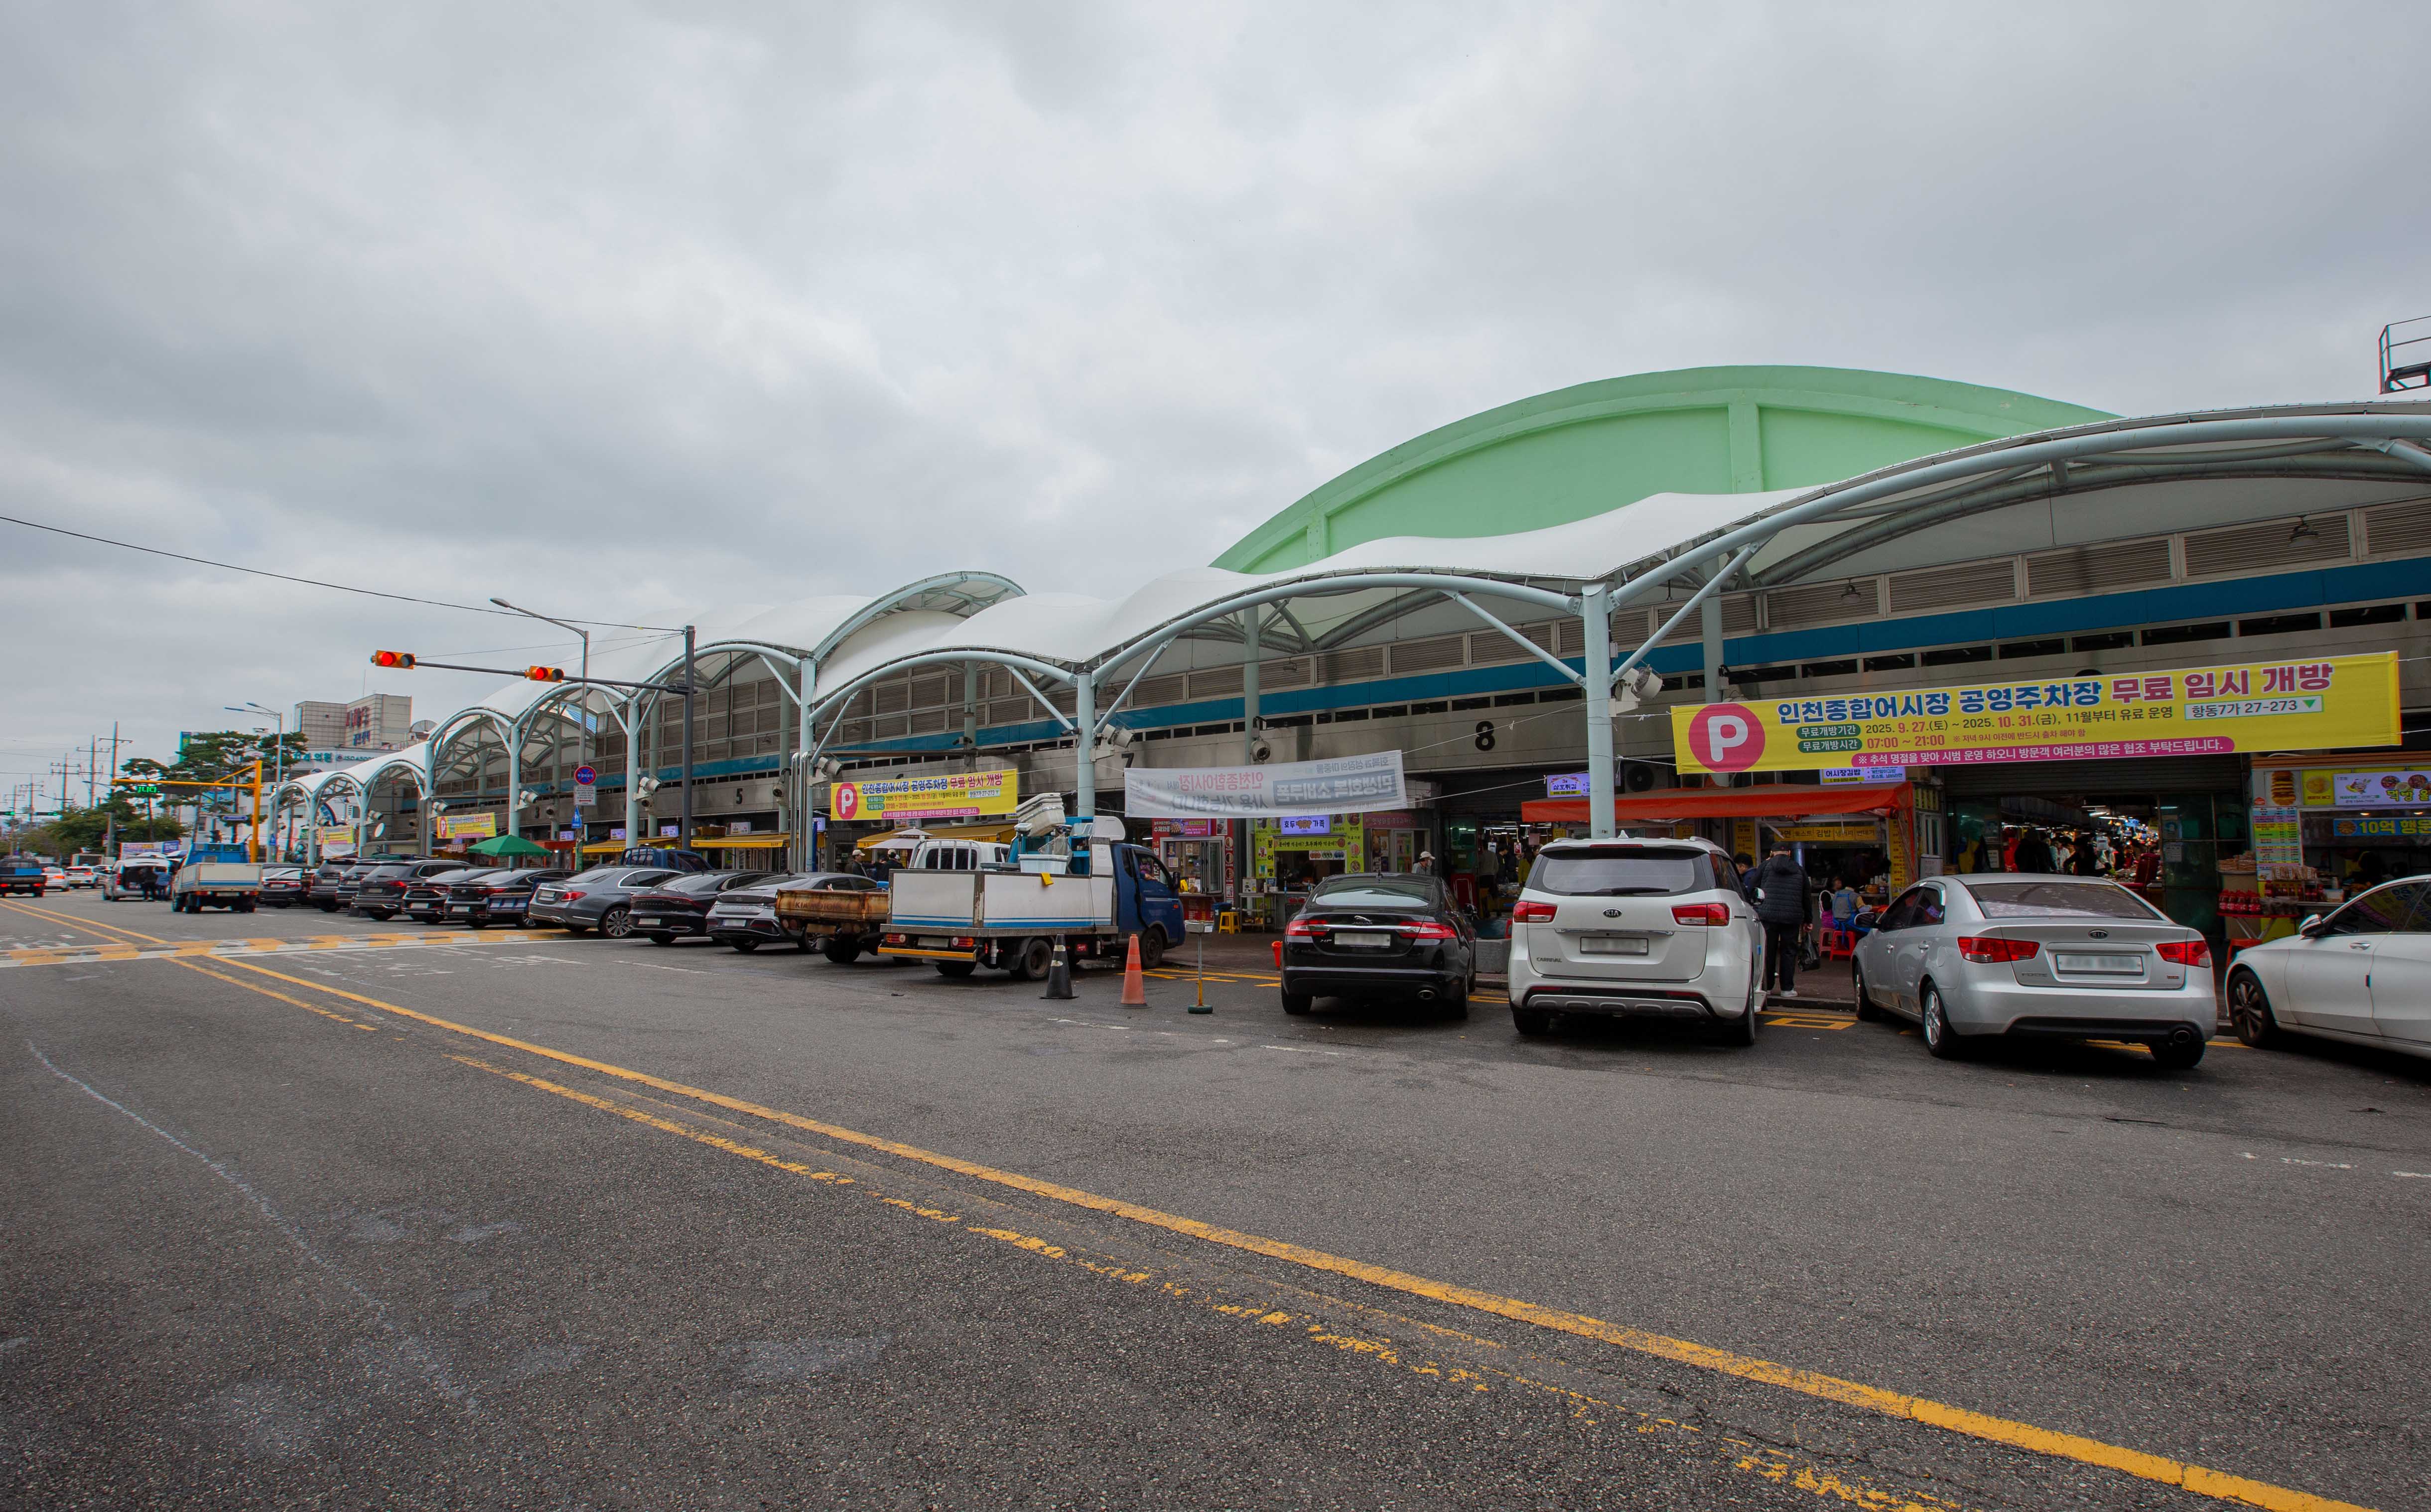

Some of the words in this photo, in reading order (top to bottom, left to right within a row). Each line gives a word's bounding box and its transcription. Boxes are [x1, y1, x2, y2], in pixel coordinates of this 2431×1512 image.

[1777, 693, 1950, 724] 인천종합어시장
[1959, 681, 2102, 713] 공영주차장
[2112, 676, 2173, 703] 무료
[2184, 670, 2249, 698] 임시
[2262, 663, 2333, 692] 개방
[2191, 703, 2240, 718] 항동7가
[2245, 700, 2297, 713] 27-273
[1801, 726, 1857, 737] 무료개방기간
[1866, 724, 1895, 734] 2025.
[1963, 718, 1994, 729] 2025.
[2065, 710, 2116, 723] 11월부터
[2120, 709, 2144, 721] 유료
[2148, 706, 2173, 719] 운영
[1475, 721, 1495, 751] 8
[1803, 740, 1858, 751] 무료개방시간
[1867, 737, 1898, 749] 07:00
[1914, 735, 1945, 747] 21:00
[1993, 732, 2015, 741] 이전에
[2017, 731, 2040, 740] 반드시
[1870, 755, 1888, 764] 추석
[1891, 753, 1917, 763] 명절을
[1920, 752, 1939, 762] 맞아
[1942, 751, 1961, 761] 시범
[1964, 750, 1983, 760] 운영
[1986, 749, 2016, 759] 하오니
[2019, 747, 2050, 758] 방문객
[2053, 745, 2095, 757] 여러분의
[2098, 744, 2120, 756] 많은
[2123, 743, 2146, 755] 협조
[2149, 739, 2223, 754] 부탁드립니다.
[1825, 768, 1861, 777] 어시장김밥
[862, 780, 909, 794] 인천종합어시장
[911, 777, 948, 792] 공영주차장
[950, 776, 966, 789] 무료
[967, 775, 984, 788] 임시
[986, 772, 1003, 786] 개방
[736, 788, 743, 804] 5
[1816, 828, 1831, 838] 김밥
[2359, 820, 2396, 834] 10억
